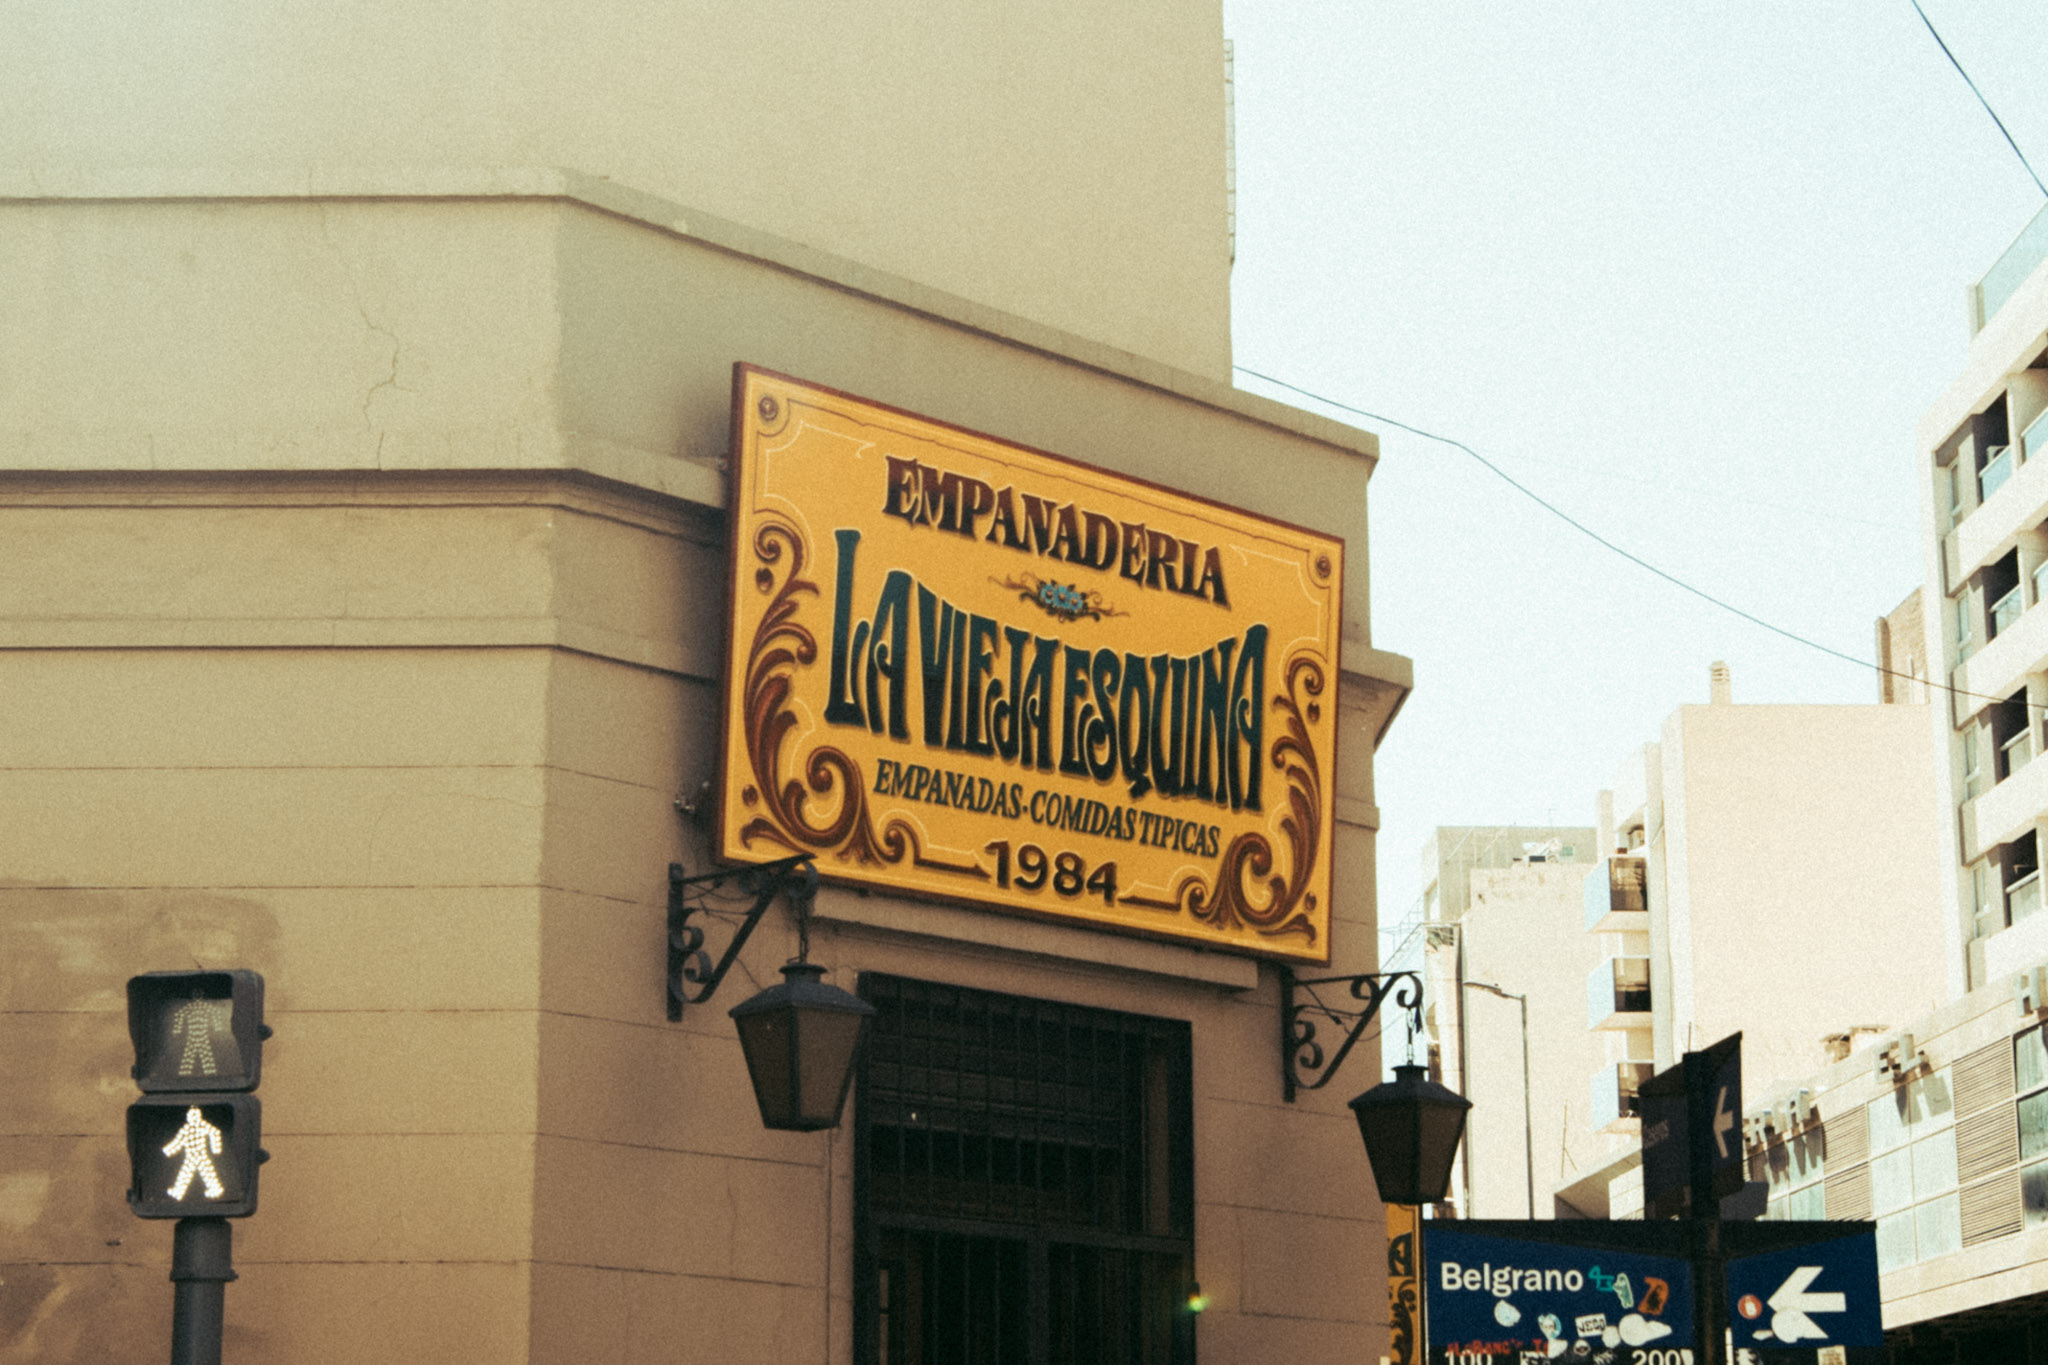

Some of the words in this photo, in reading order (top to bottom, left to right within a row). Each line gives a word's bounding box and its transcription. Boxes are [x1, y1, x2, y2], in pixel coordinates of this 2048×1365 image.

[881, 454, 1231, 610] EMPANADERIA
[824, 529, 912, 740] LA
[916, 579, 1060, 774] VIEJA
[1056, 623, 1269, 812] ESQUINA
[1138, 811, 1222, 858] TIPICAS
[984, 839, 1118, 904] 1984
[1440, 1262, 1584, 1298] Belgrano
